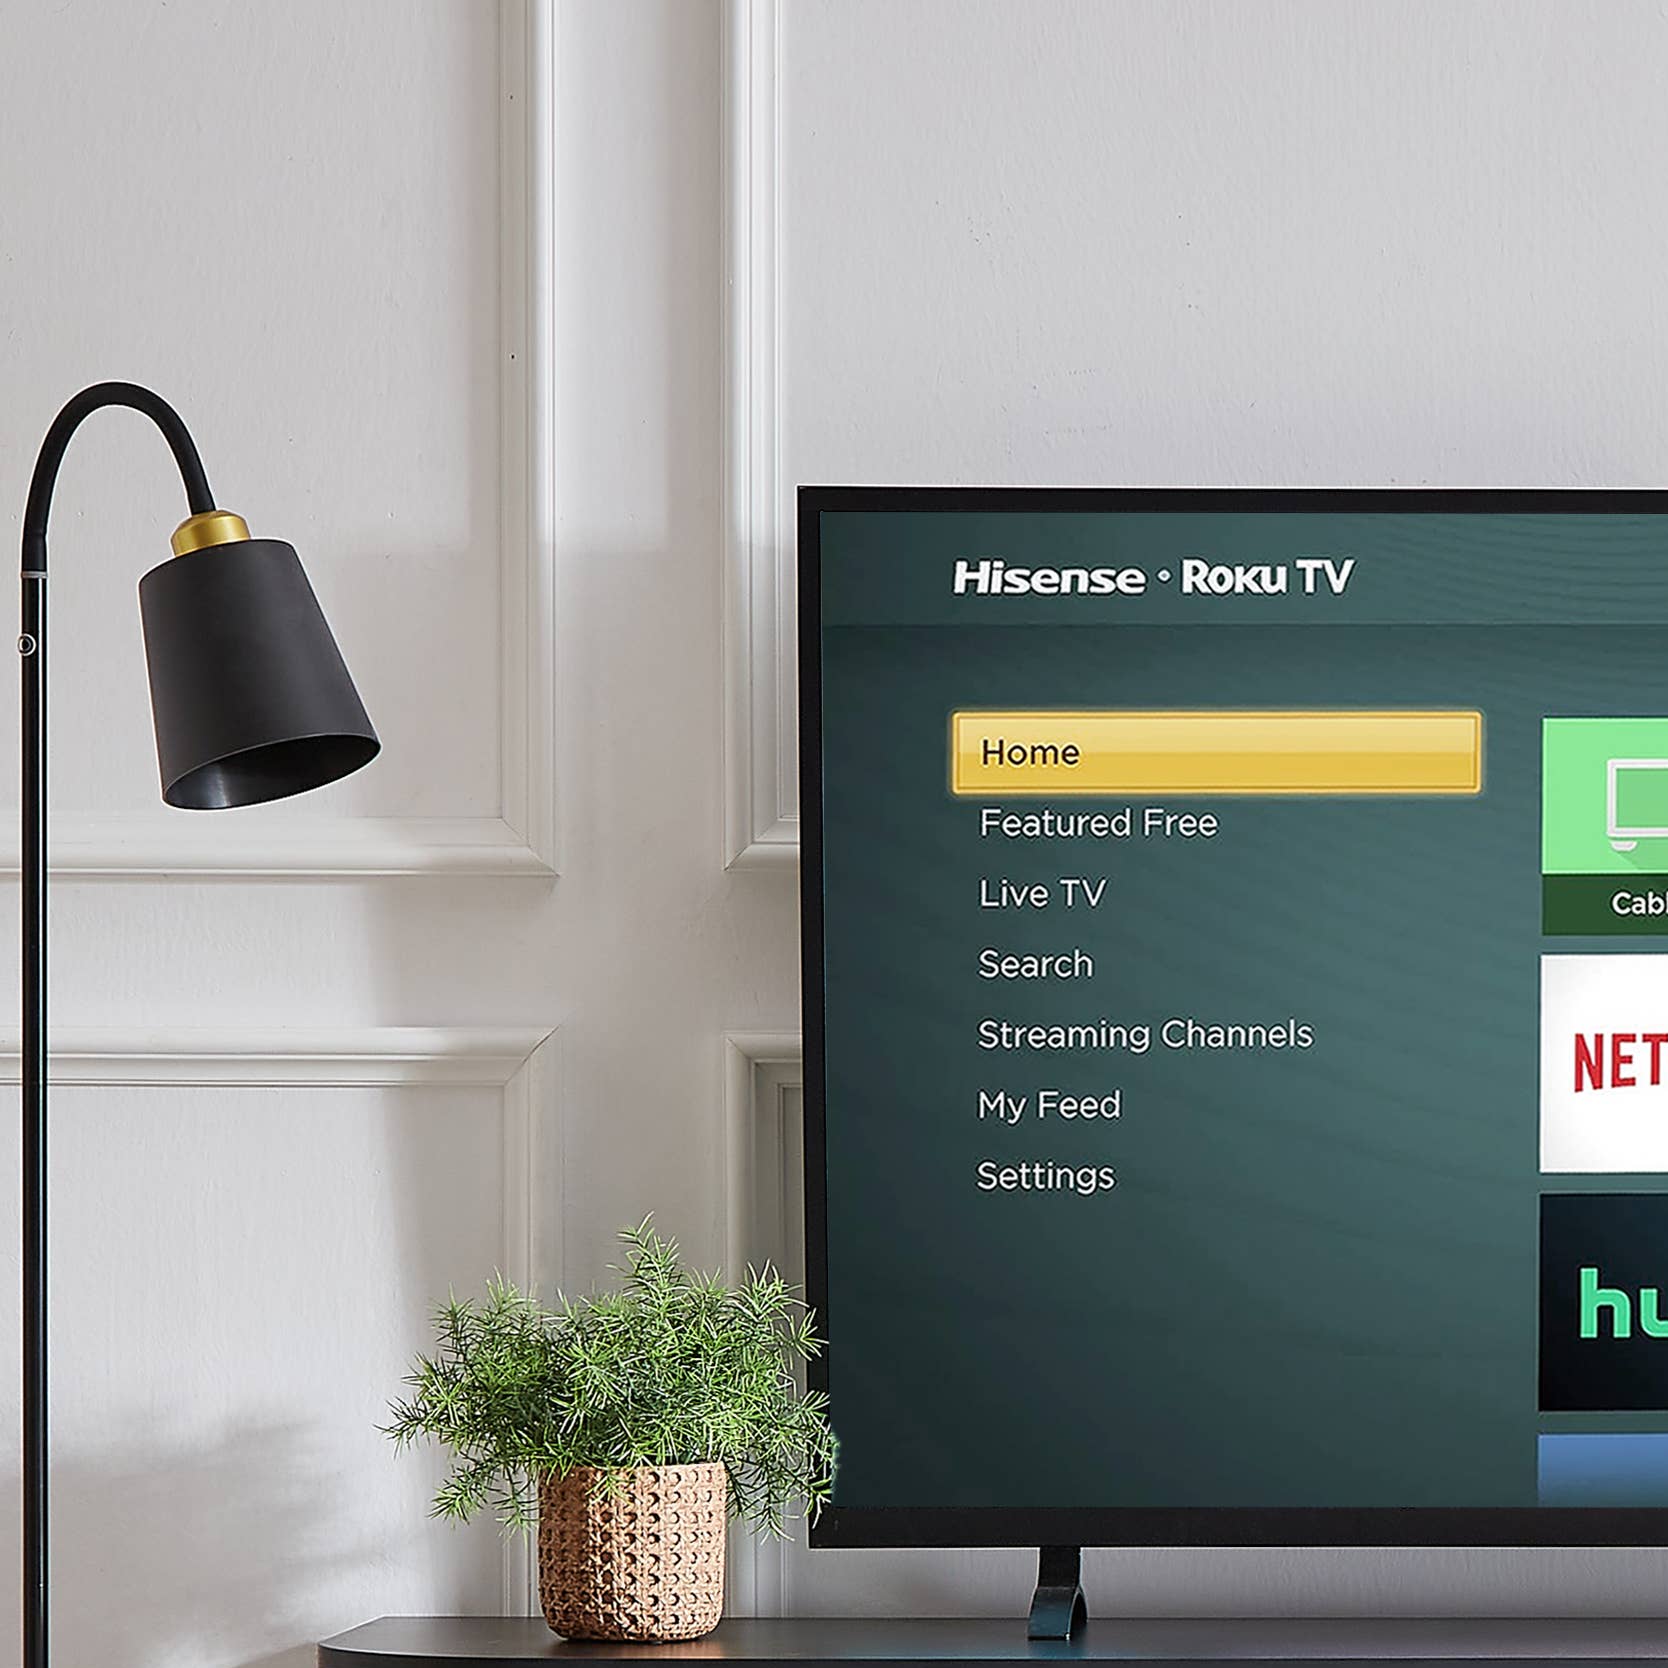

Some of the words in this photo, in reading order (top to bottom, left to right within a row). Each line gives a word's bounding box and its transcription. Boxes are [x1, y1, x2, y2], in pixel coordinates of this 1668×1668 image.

[954, 559, 1145, 595] Hisense
[1296, 560, 1355, 595] TV
[982, 740, 1080, 766] Home
[982, 808, 1130, 836] Featured
[1143, 809, 1217, 838] Free
[982, 880, 1048, 906] Live
[1060, 878, 1105, 908] TV
[980, 950, 1092, 977] Search
[980, 1021, 1149, 1053] Streaming
[1162, 1018, 1312, 1049] Channels
[980, 1092, 1026, 1123] My
[1040, 1090, 1119, 1118] Feed
[978, 1162, 1114, 1194] Settings
